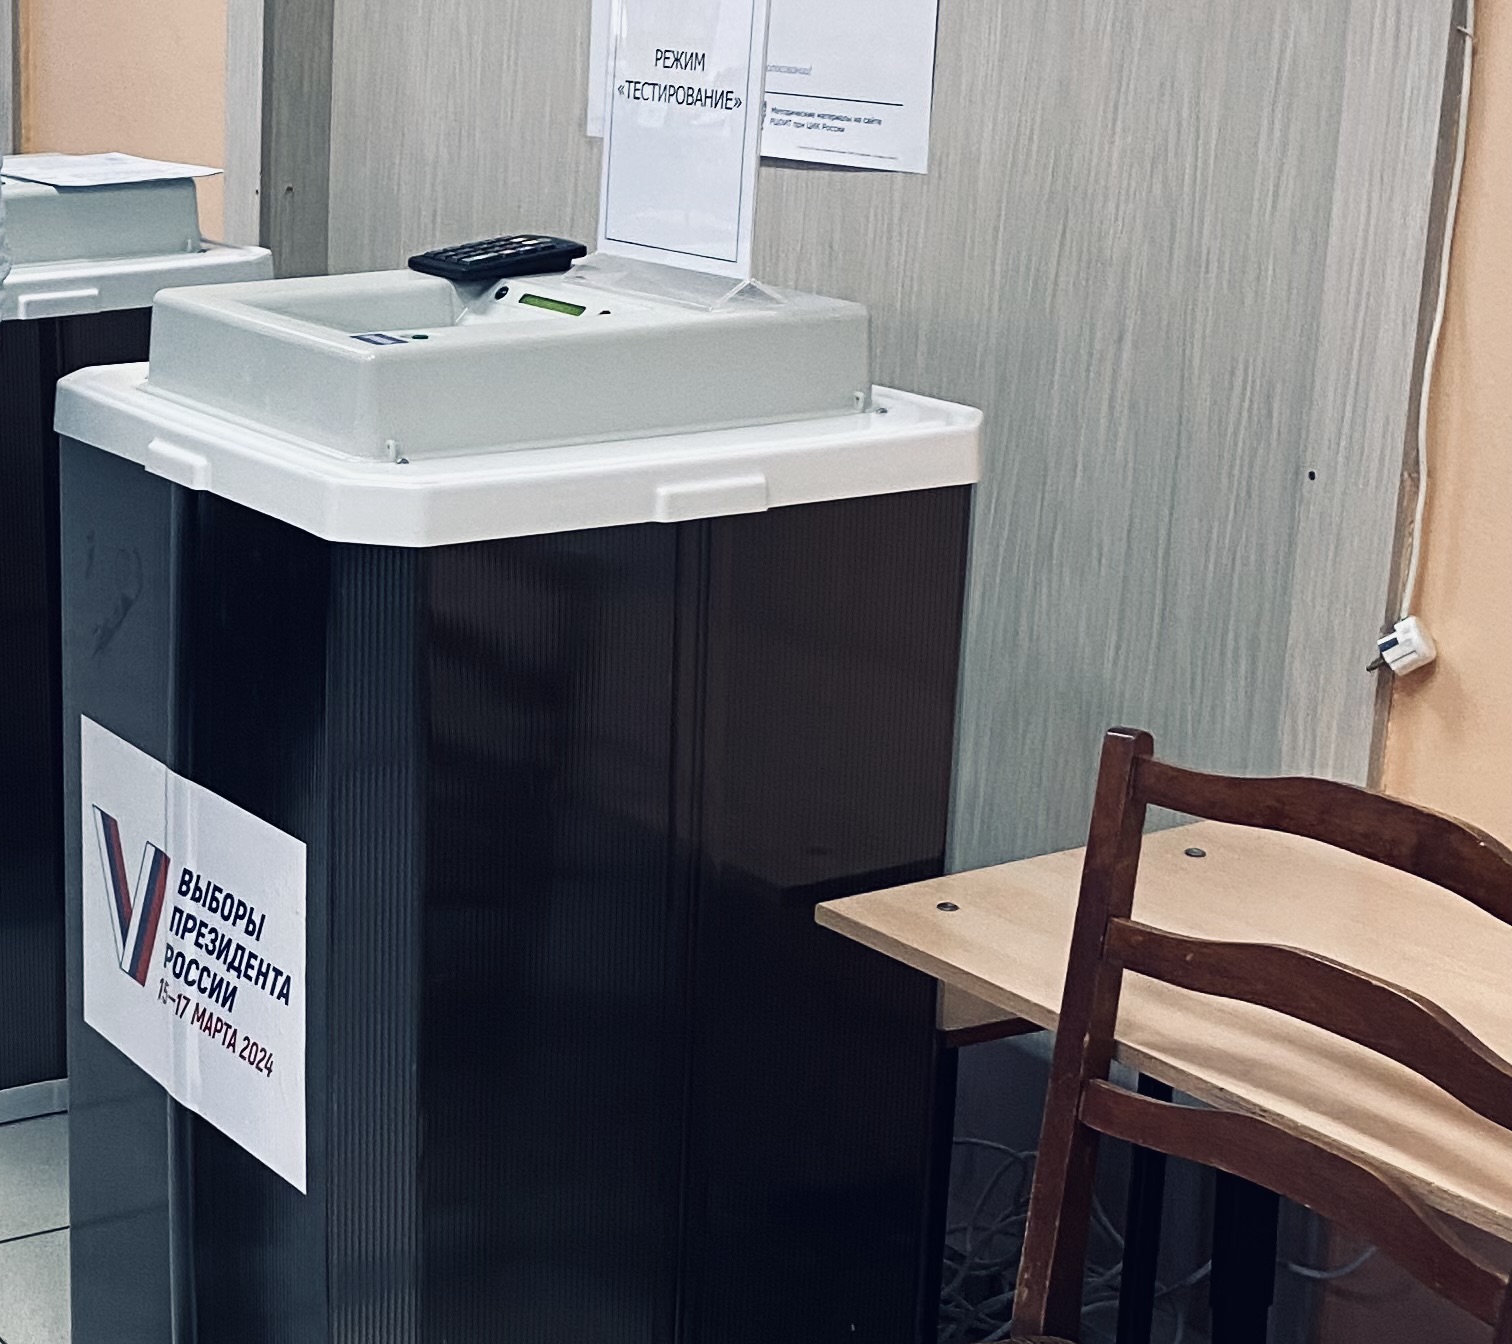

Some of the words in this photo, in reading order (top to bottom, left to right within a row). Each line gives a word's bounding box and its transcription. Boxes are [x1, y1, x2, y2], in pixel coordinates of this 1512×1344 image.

[617, 79, 743, 110] «ТЕСТИРОВАНИЕ»
[655, 49, 706, 71] РЕЖИМ
[178, 867, 266, 942] ВЫБОРЫ
[163, 942, 239, 1013] РОССИИ
[169, 906, 291, 1007] ПРЕЗИДЕНТА
[190, 1002, 239, 1054] МАРТА
[238, 1035, 274, 1077] 2024
